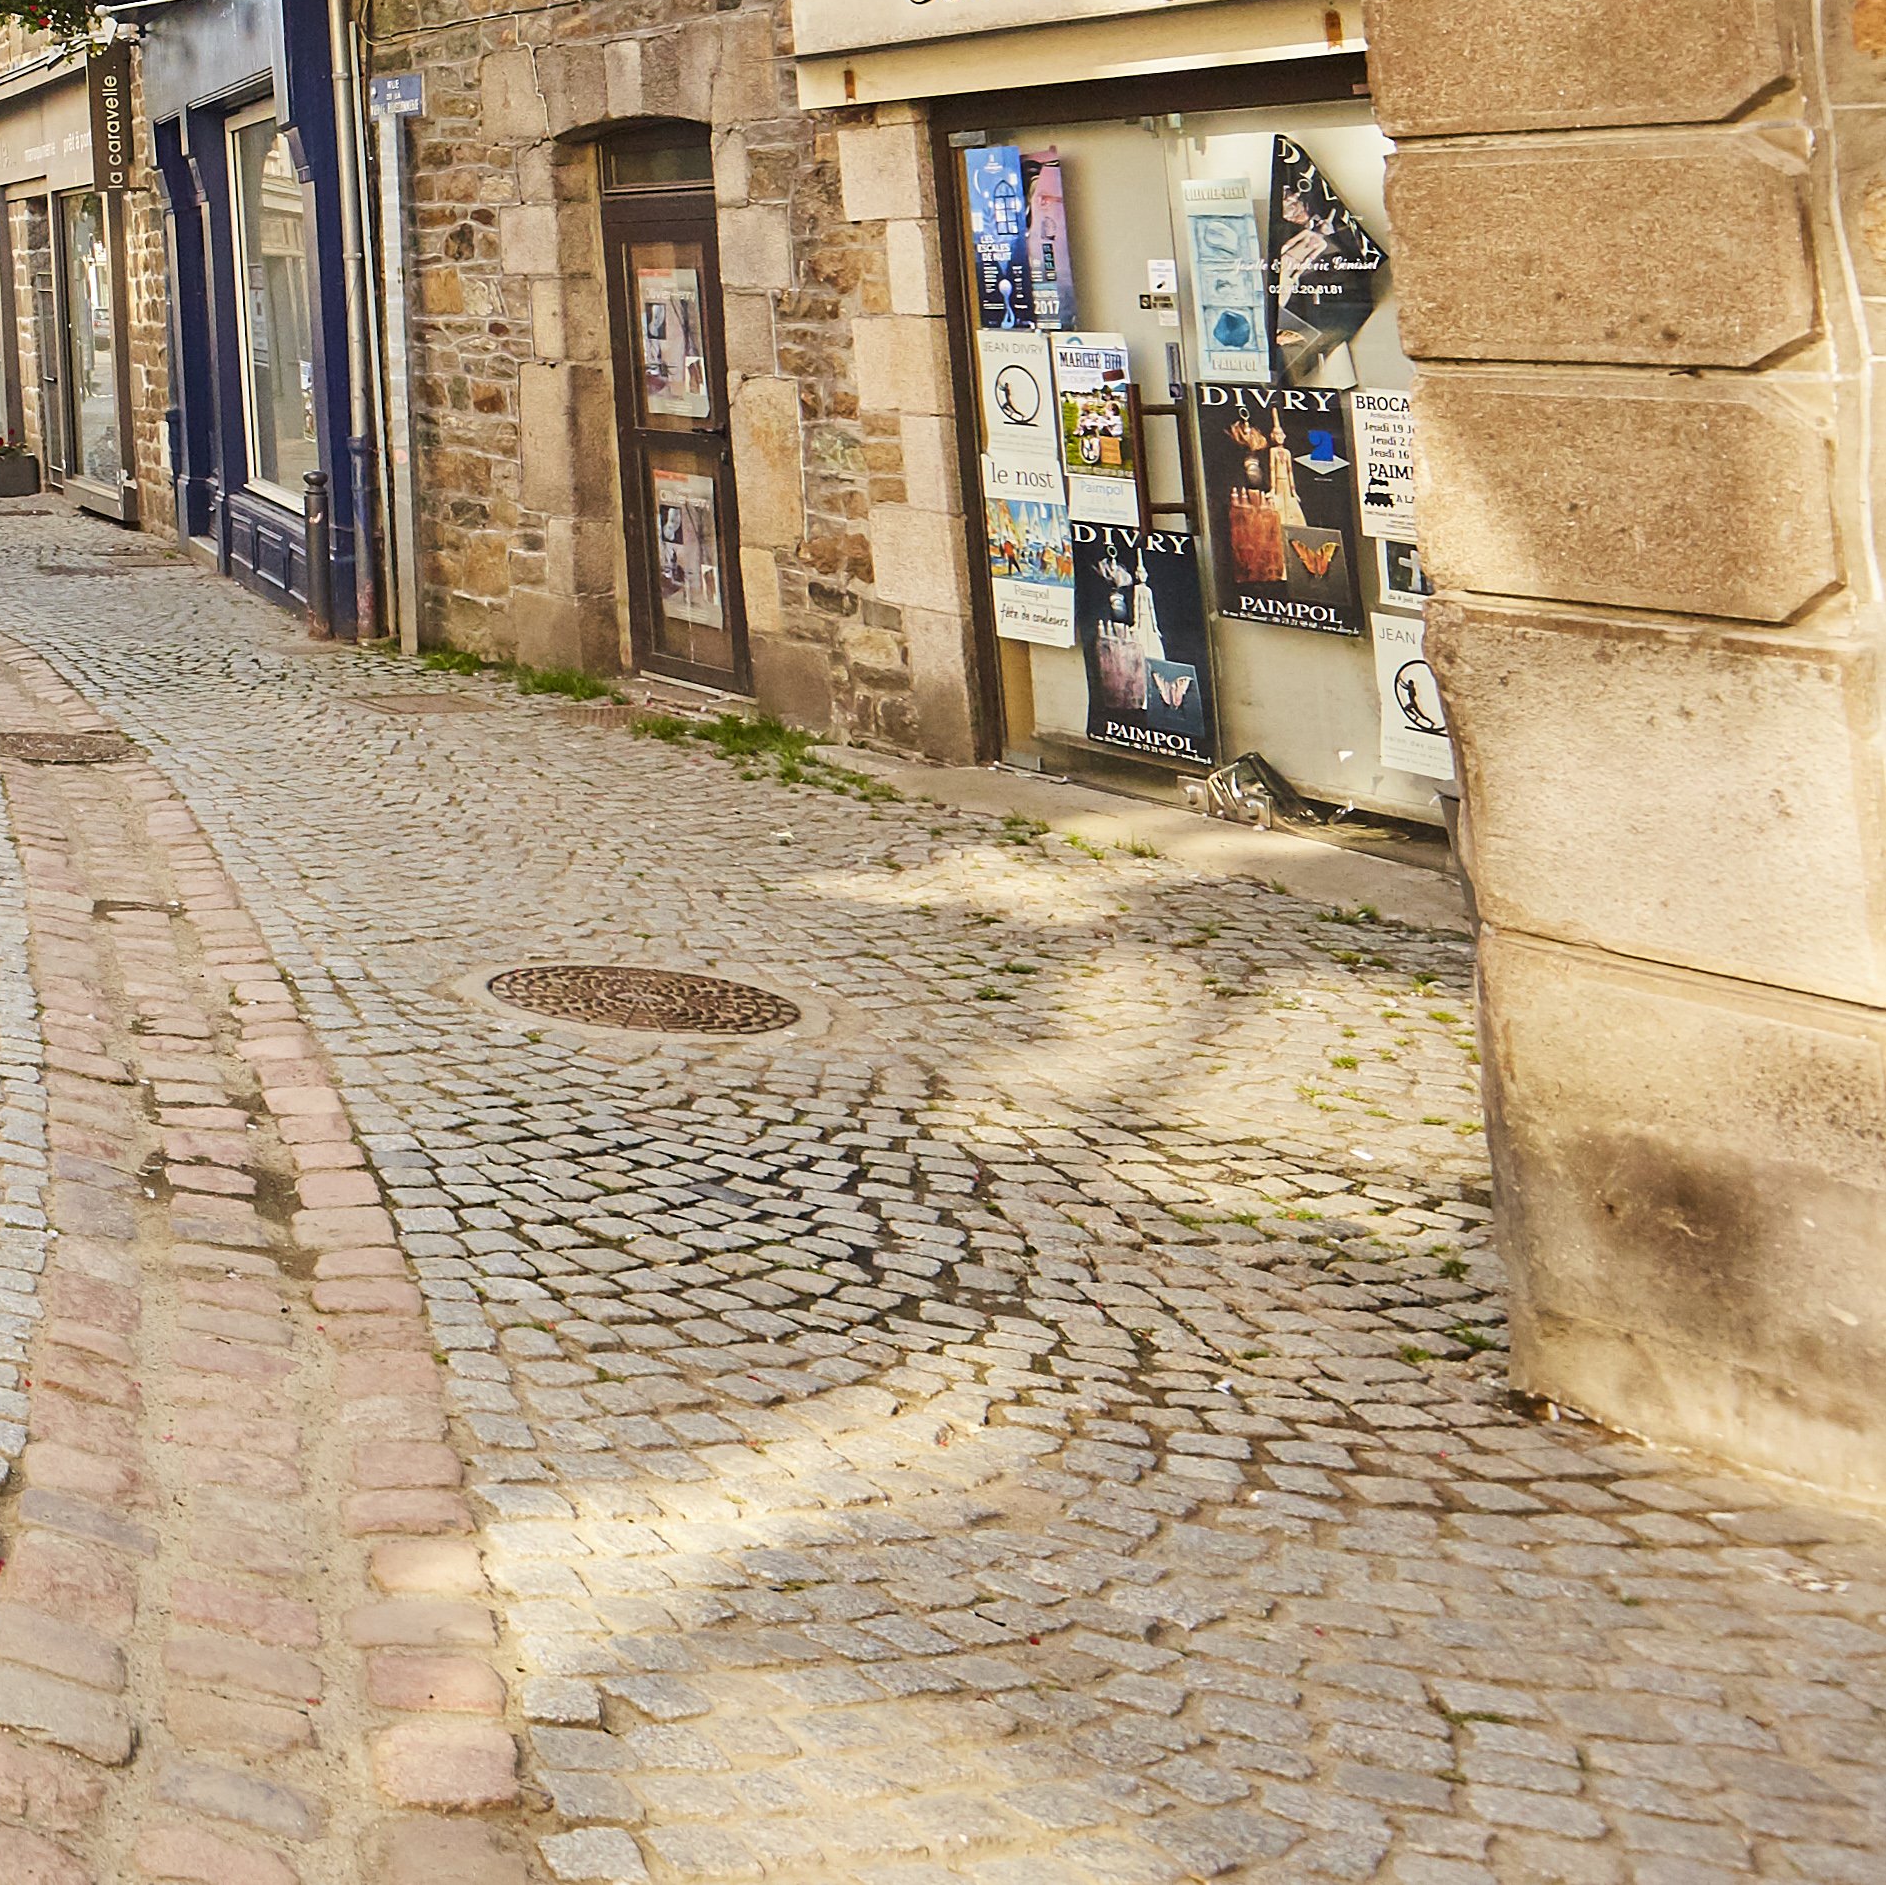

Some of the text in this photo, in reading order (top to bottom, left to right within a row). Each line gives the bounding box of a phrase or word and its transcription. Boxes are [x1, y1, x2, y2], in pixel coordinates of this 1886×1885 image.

[387, 79, 399, 90] RUE
[108, 171, 123, 189] la
[977, 243, 1011, 253] ESCALES
[982, 251, 1012, 262] DE NUIT
[1034, 300, 1060, 315] 2017
[983, 341, 1044, 355] JEAN DIVRY
[1200, 386, 1336, 412] DIVRY
[1356, 395, 1411, 412] BROCA
[1363, 422, 1389, 433] Jeudi
[1393, 424, 1403, 434] 19
[1370, 435, 1396, 446] Jeudi
[1399, 437, 1405, 446] 2
[1369, 447, 1409, 460] Jeudi 16
[991, 462, 1008, 484] le
[1016, 469, 1055, 489] nost
[1080, 481, 1124, 497] Paimpol
[1072, 524, 1190, 555] DIVRY
[1239, 595, 1343, 625] PAIMPOL
[1379, 627, 1416, 645] JEAN
[1106, 721, 1197, 754] PAIMPOL
